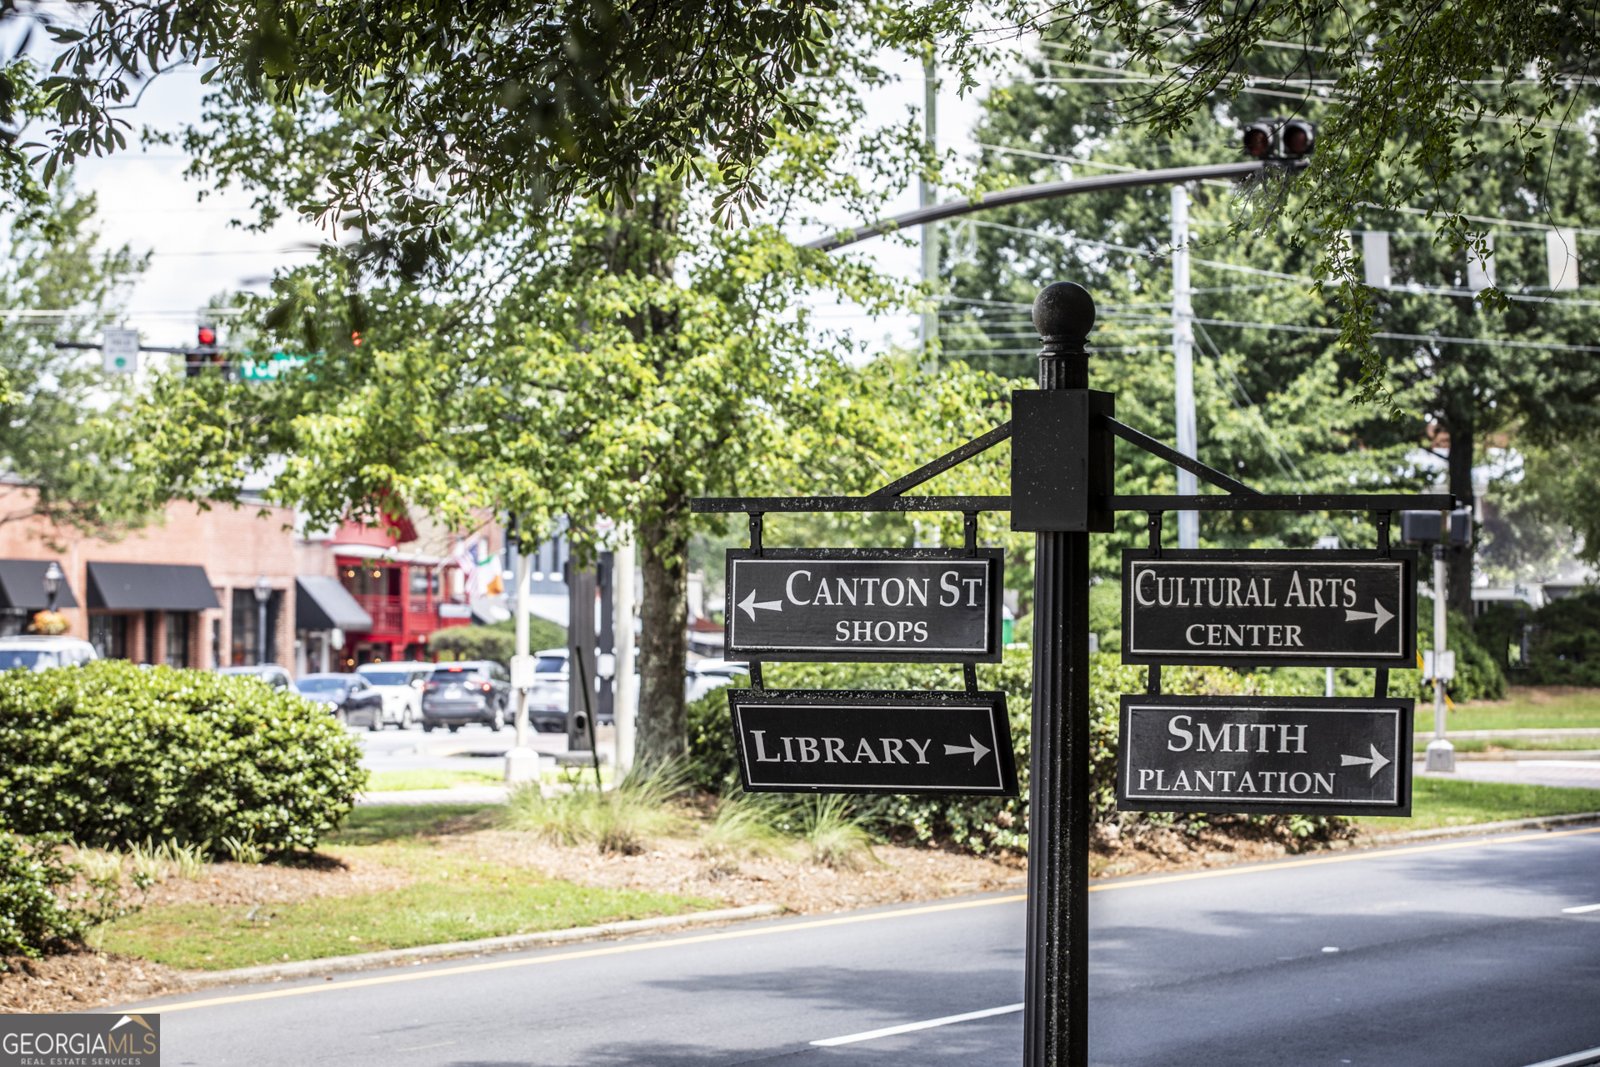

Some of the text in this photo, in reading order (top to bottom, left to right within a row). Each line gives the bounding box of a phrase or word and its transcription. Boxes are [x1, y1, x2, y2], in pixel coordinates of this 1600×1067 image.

[785, 570, 930, 607] CANTON
[1135, 569, 1357, 609] CULTURAL ARTS
[835, 620, 929, 643] SHOPS
[1185, 623, 1304, 647] CENTER
[750, 730, 932, 765] LIBRARY
[1167, 714, 1309, 754] SMITH
[1138, 769, 1336, 795] PLANTATION
